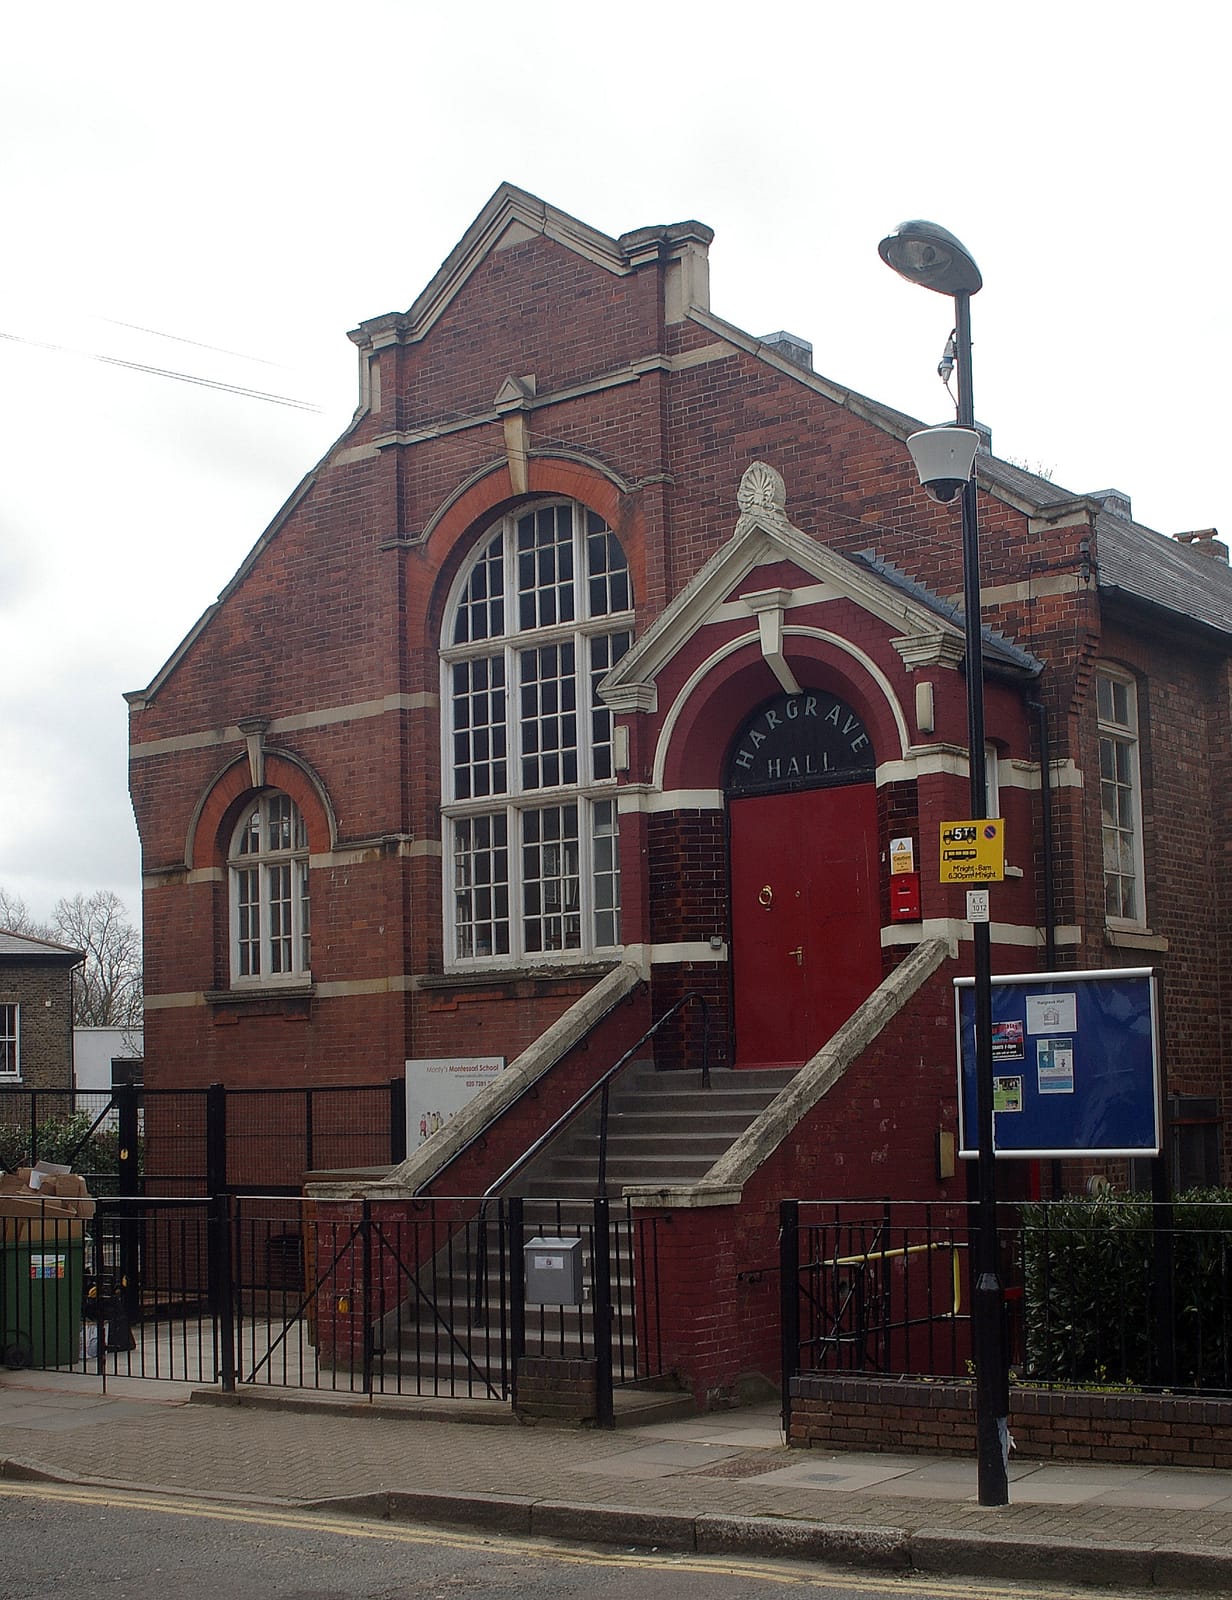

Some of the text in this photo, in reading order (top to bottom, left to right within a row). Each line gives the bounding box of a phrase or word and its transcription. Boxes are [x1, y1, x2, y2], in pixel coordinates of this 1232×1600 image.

[735, 696, 869, 769] HARGRAVE
[768, 752, 835, 779] HALL
[449, 1064, 478, 1073] Montessori
[479, 1063, 499, 1072] School
